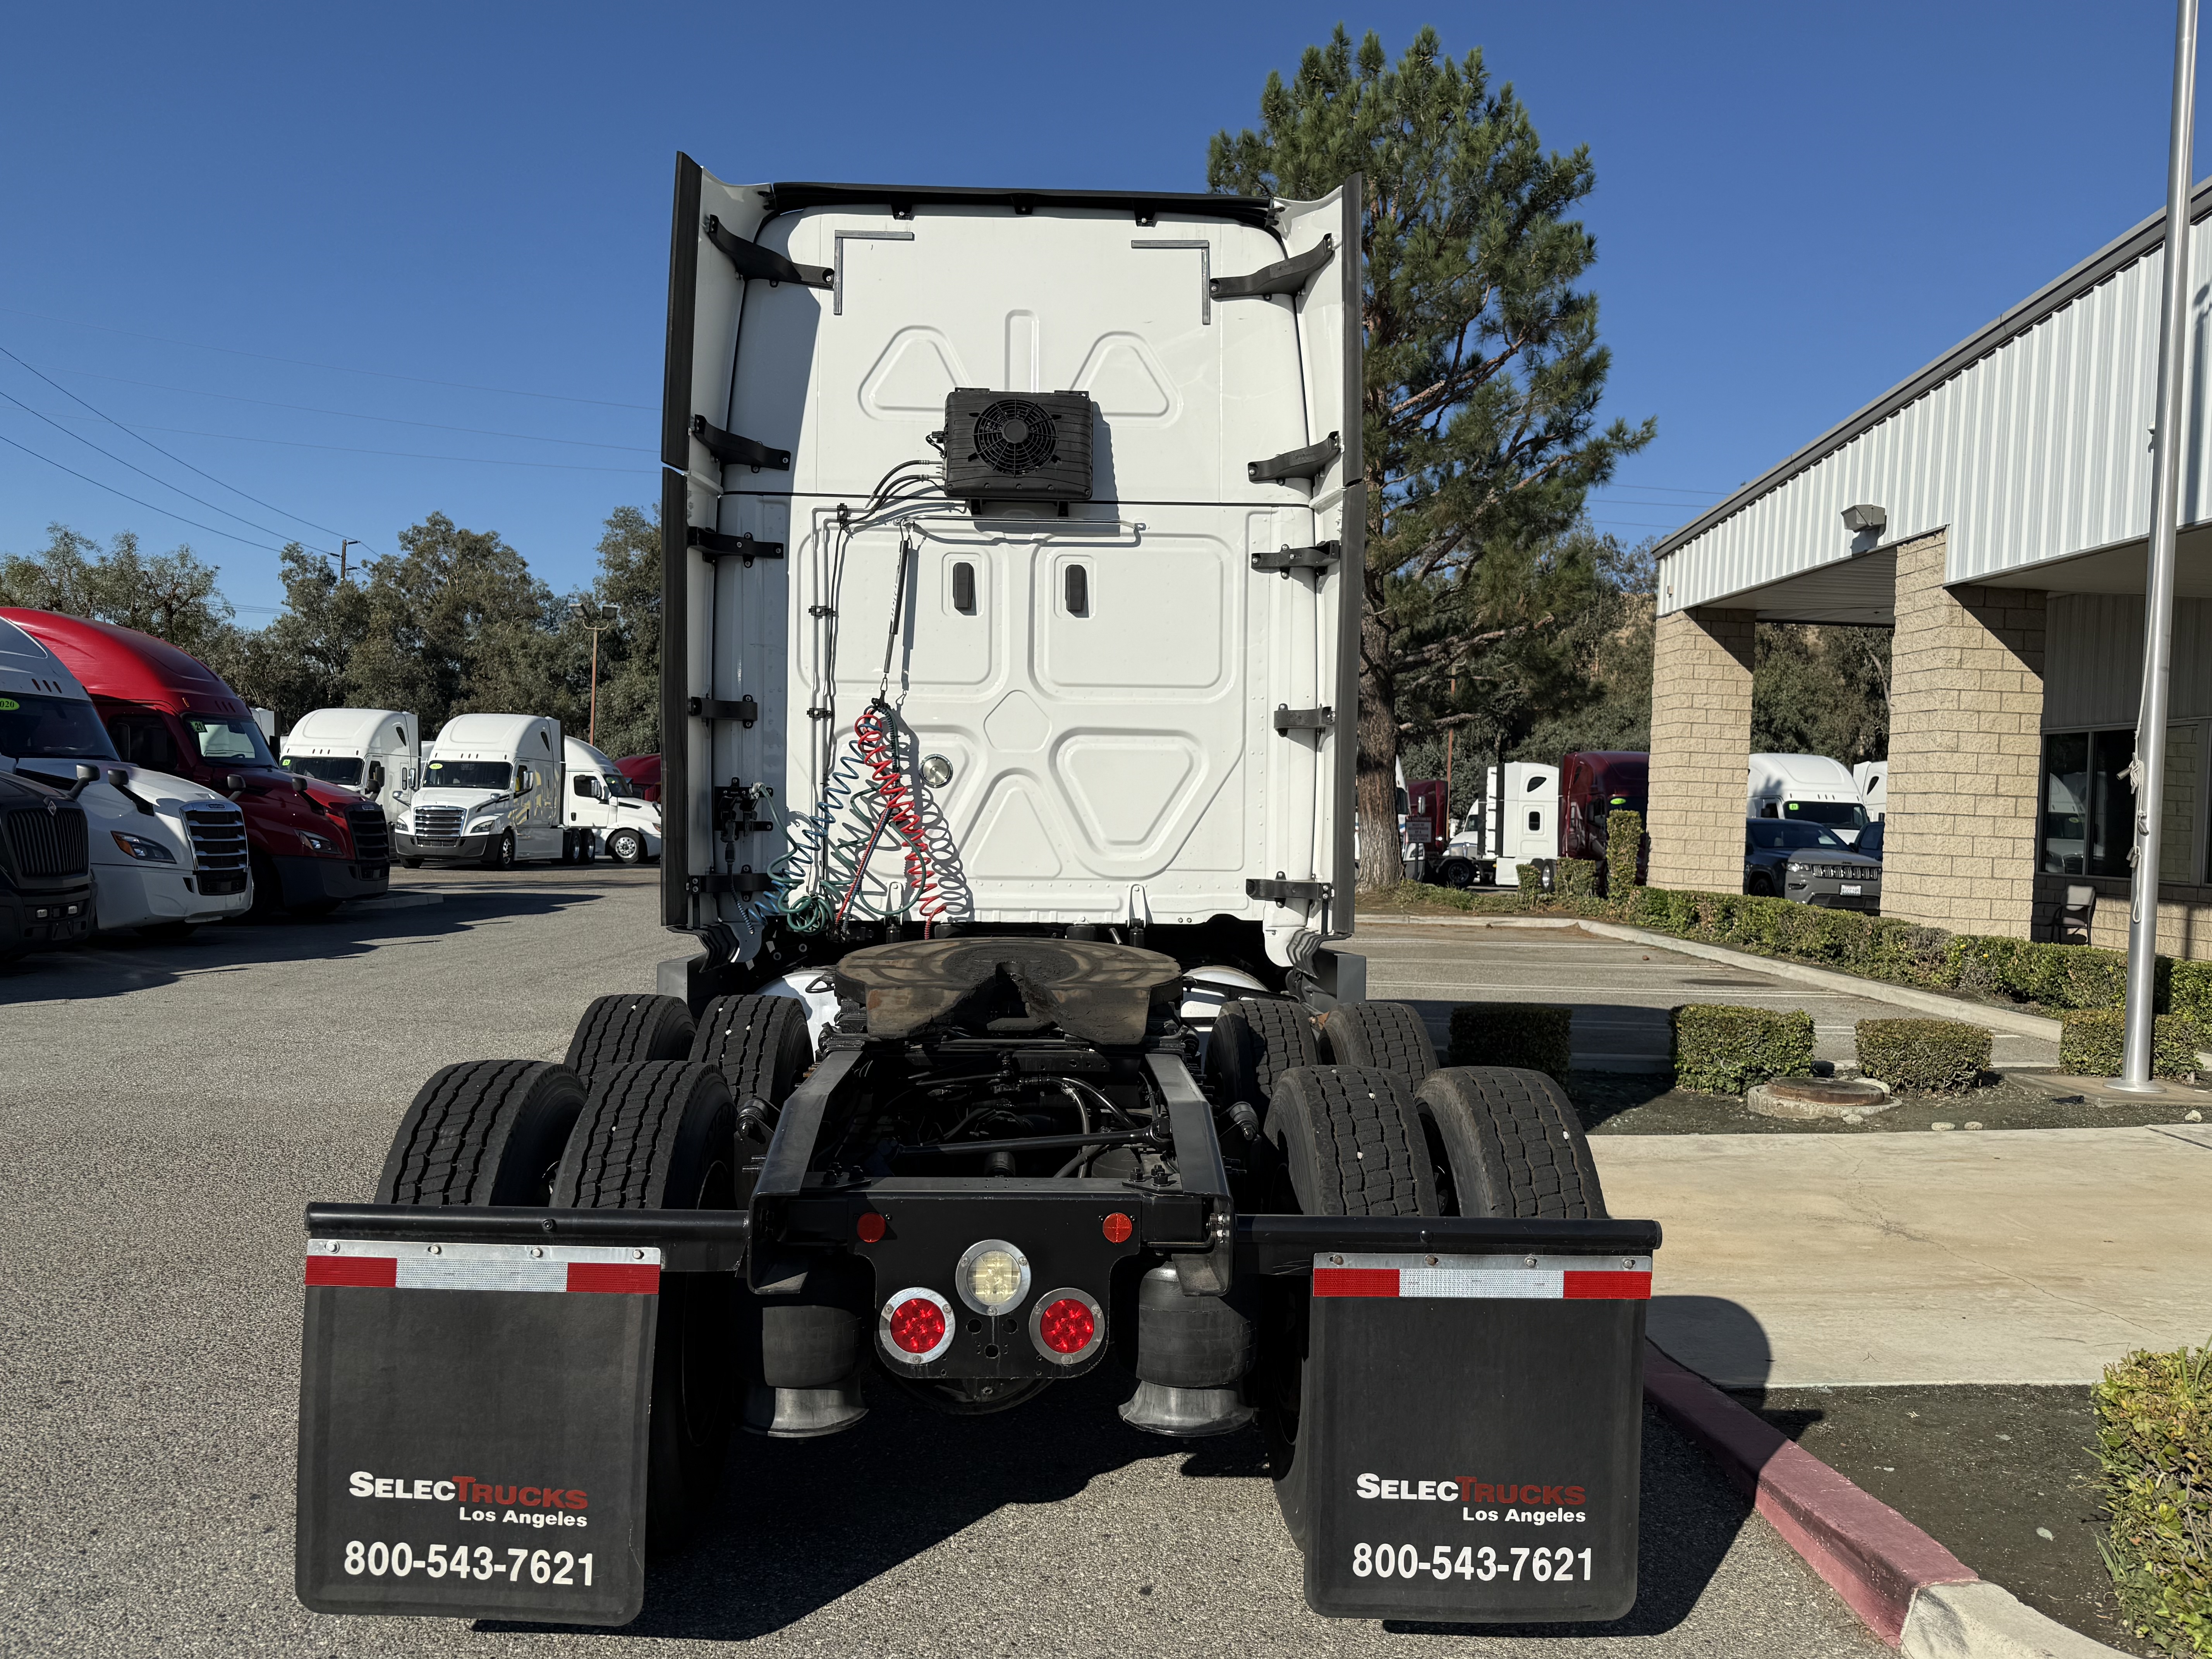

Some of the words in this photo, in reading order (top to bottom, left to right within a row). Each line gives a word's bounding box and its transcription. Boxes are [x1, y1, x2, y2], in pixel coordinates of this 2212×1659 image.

[349, 1471, 588, 1509] SELECTRUCKS
[1357, 1473, 1586, 1504] SELECTRUCKS
[459, 1507, 496, 1522] Los
[503, 1510, 587, 1528] Angeles
[1463, 1507, 1498, 1521] Los
[1504, 1508, 1586, 1525] Angeles
[344, 1540, 592, 1586] 800-543-7621
[1353, 1542, 1591, 1581] 800-543-7621
